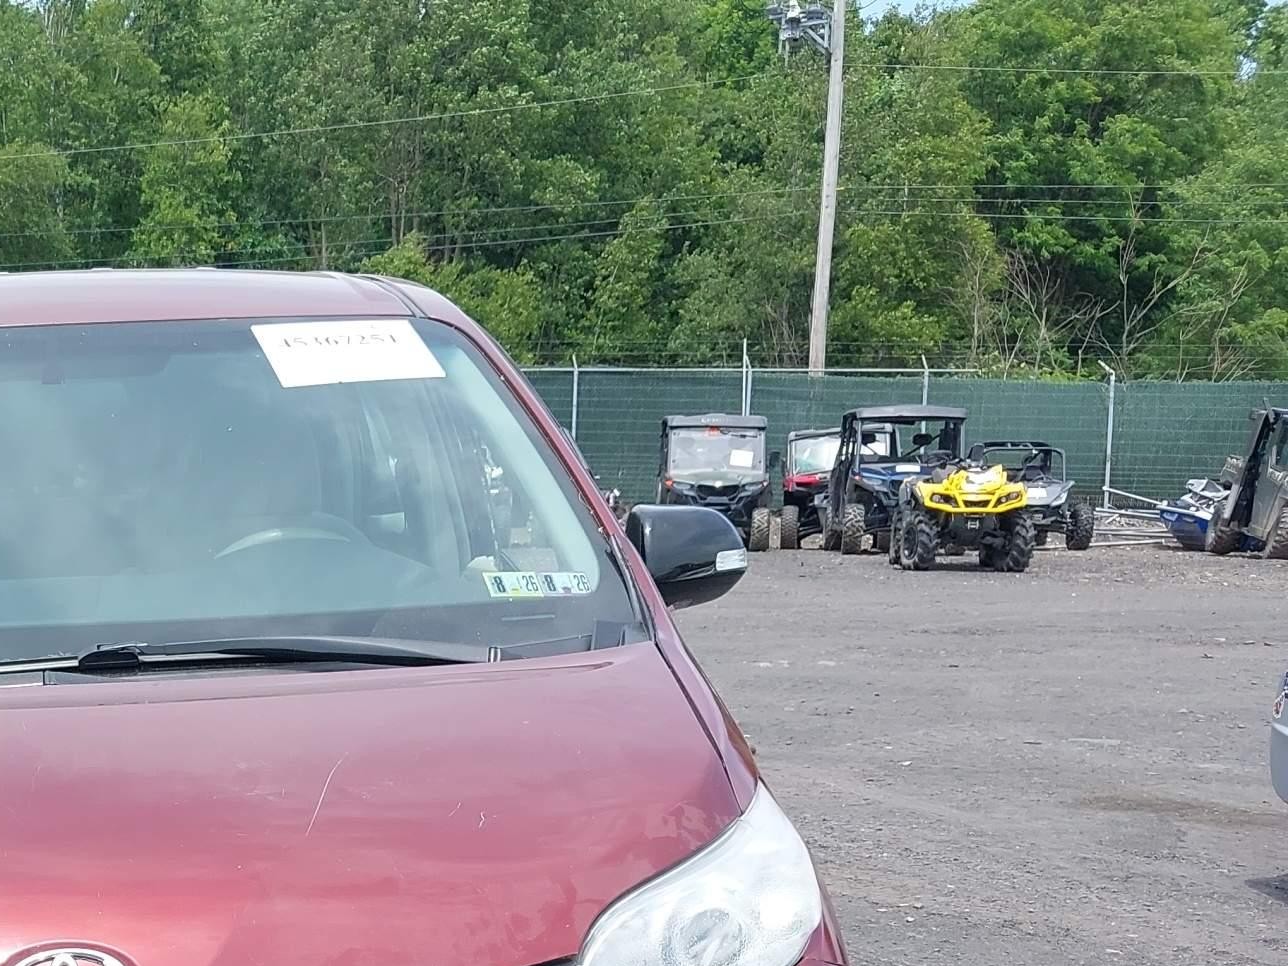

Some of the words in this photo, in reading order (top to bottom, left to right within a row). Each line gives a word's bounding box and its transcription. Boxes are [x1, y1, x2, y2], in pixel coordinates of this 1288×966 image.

[494, 576, 507, 593] 8
[521, 575, 540, 593] 26
[544, 574, 557, 593] 8
[573, 574, 590, 593] 26
